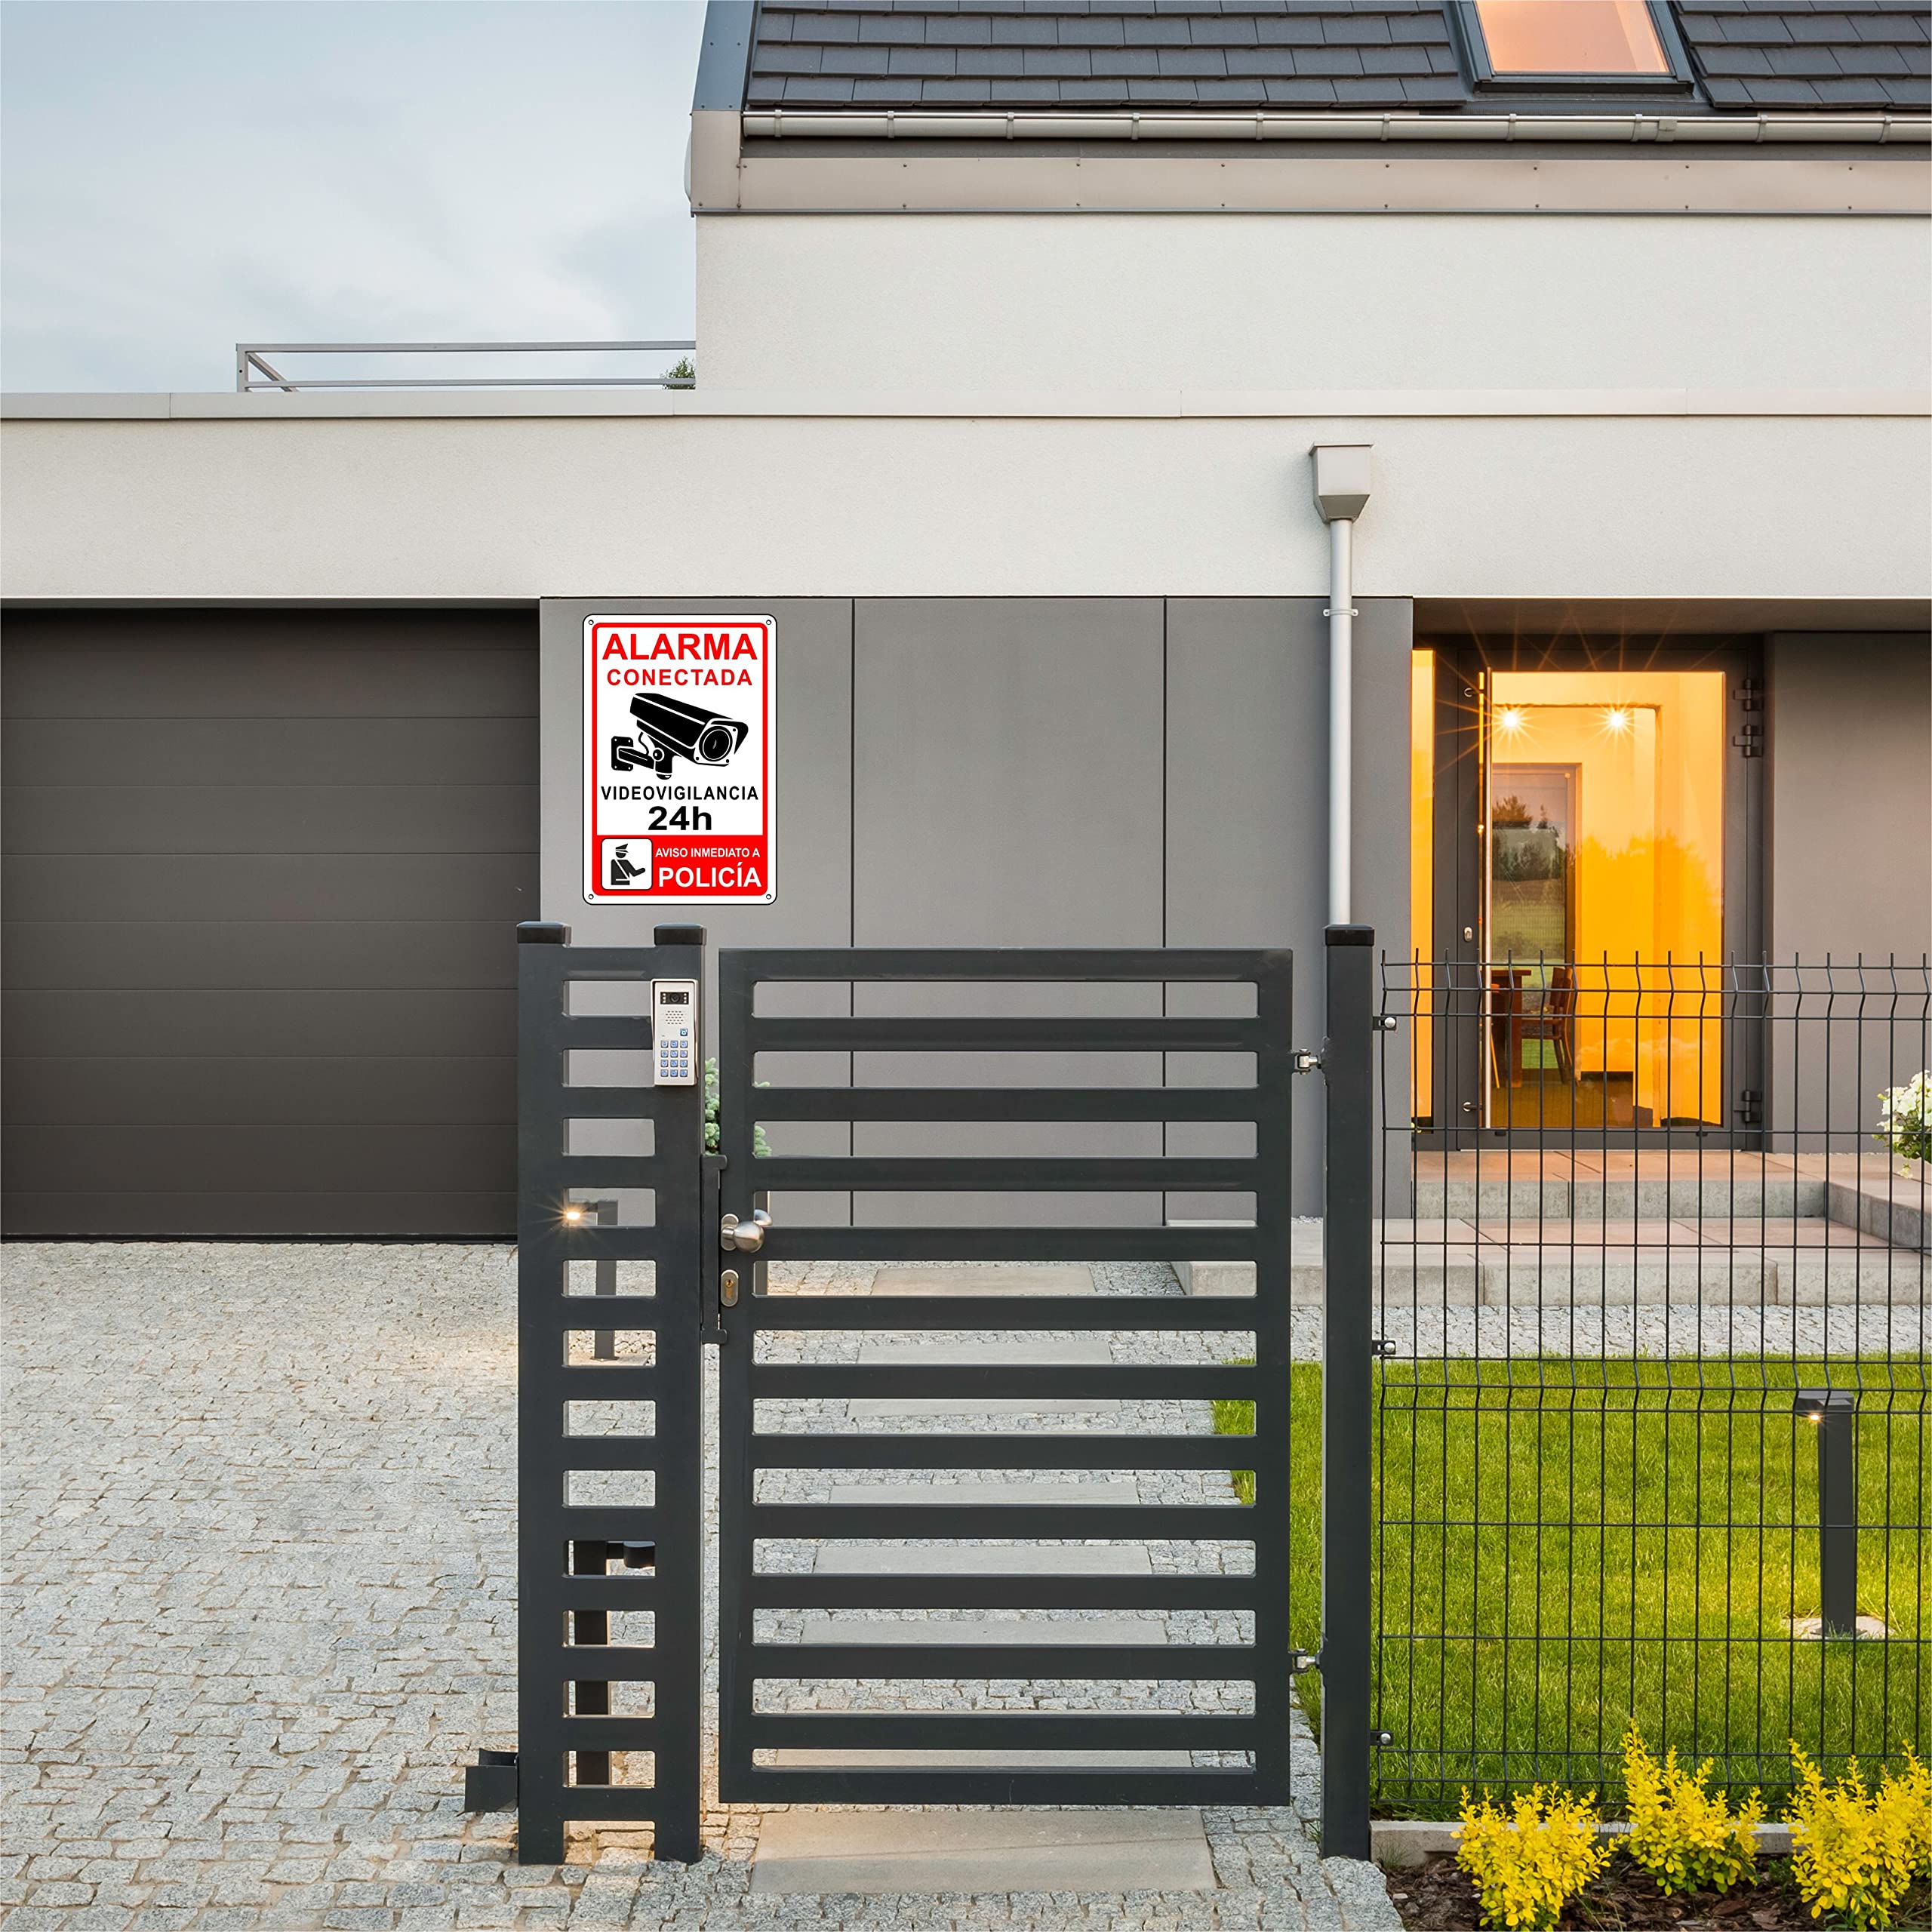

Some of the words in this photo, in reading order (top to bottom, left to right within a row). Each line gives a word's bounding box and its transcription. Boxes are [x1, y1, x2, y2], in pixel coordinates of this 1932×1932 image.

[602, 633, 758, 660] ALARMA
[607, 669, 752, 686] CONECTADA
[601, 786, 758, 801] VIDEOVIGILANCIA
[648, 806, 712, 830] 24h
[655, 848, 688, 858] AVISO
[691, 848, 750, 858] INMEDIATO
[752, 848, 761, 857] A
[659, 862, 762, 888] POLICÍA
